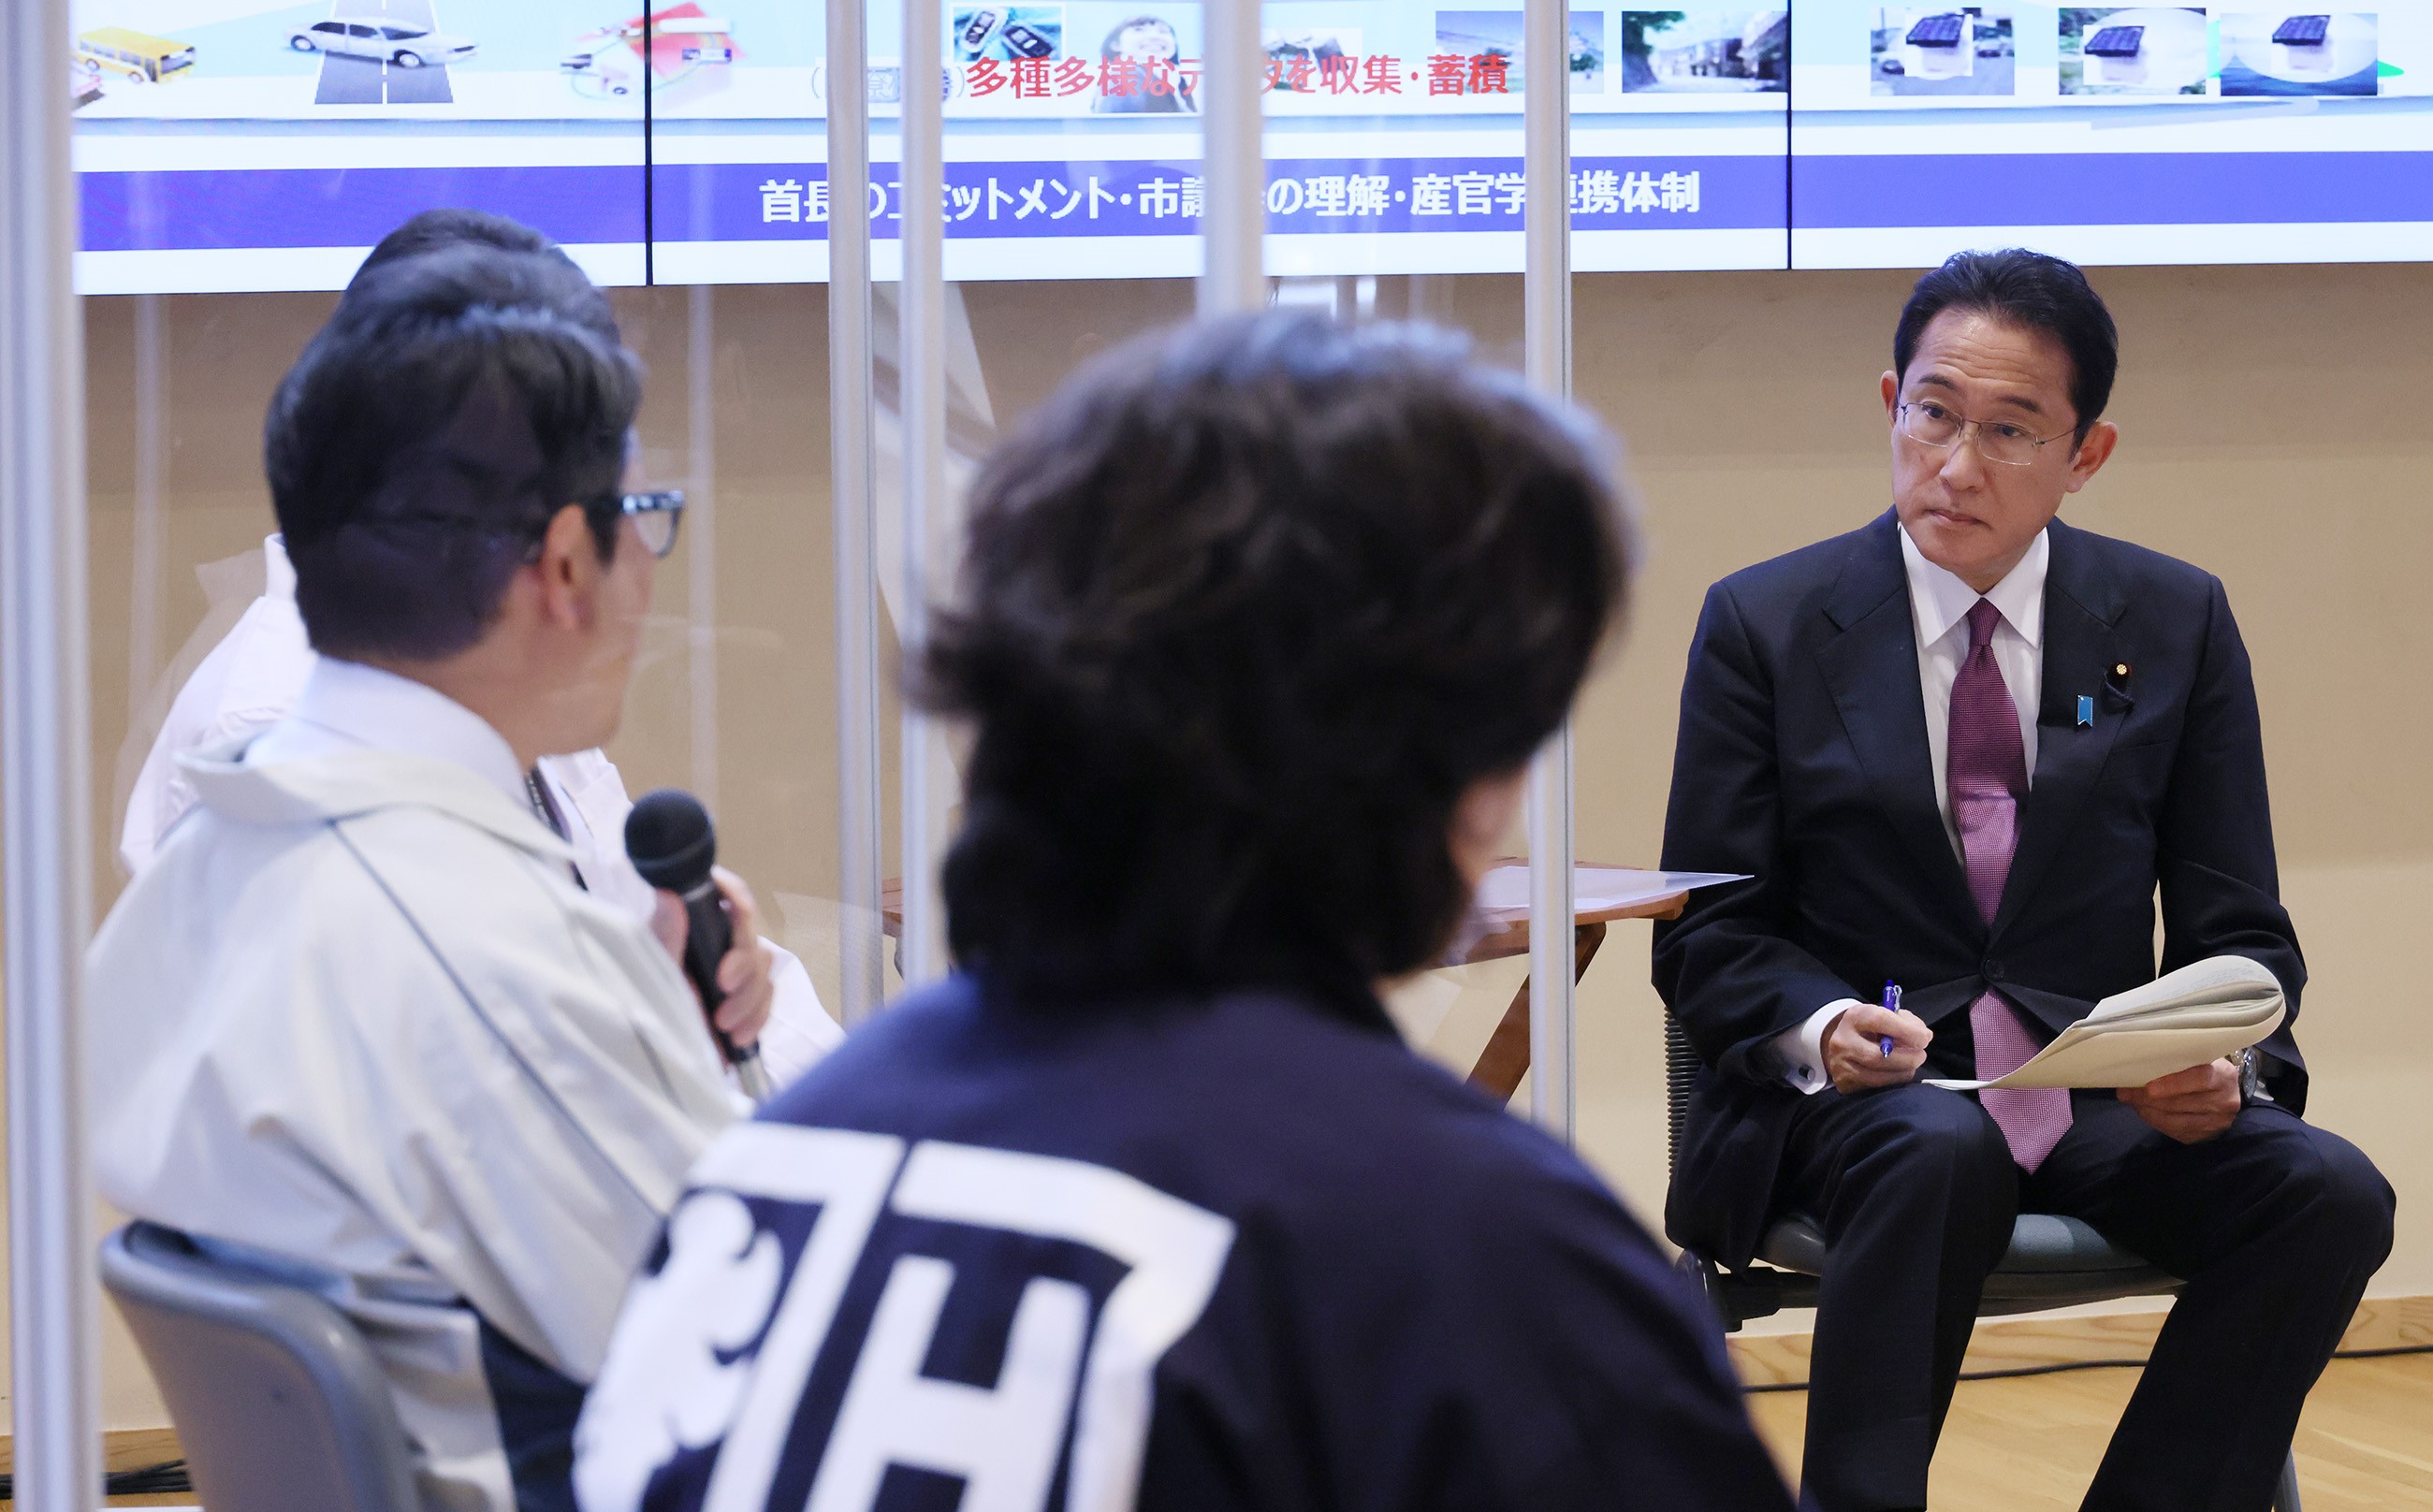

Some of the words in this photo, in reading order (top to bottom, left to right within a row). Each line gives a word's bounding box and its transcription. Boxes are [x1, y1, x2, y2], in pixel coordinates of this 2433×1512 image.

[967, 54, 1508, 99] 多種多様なデタを収集・蓄積
